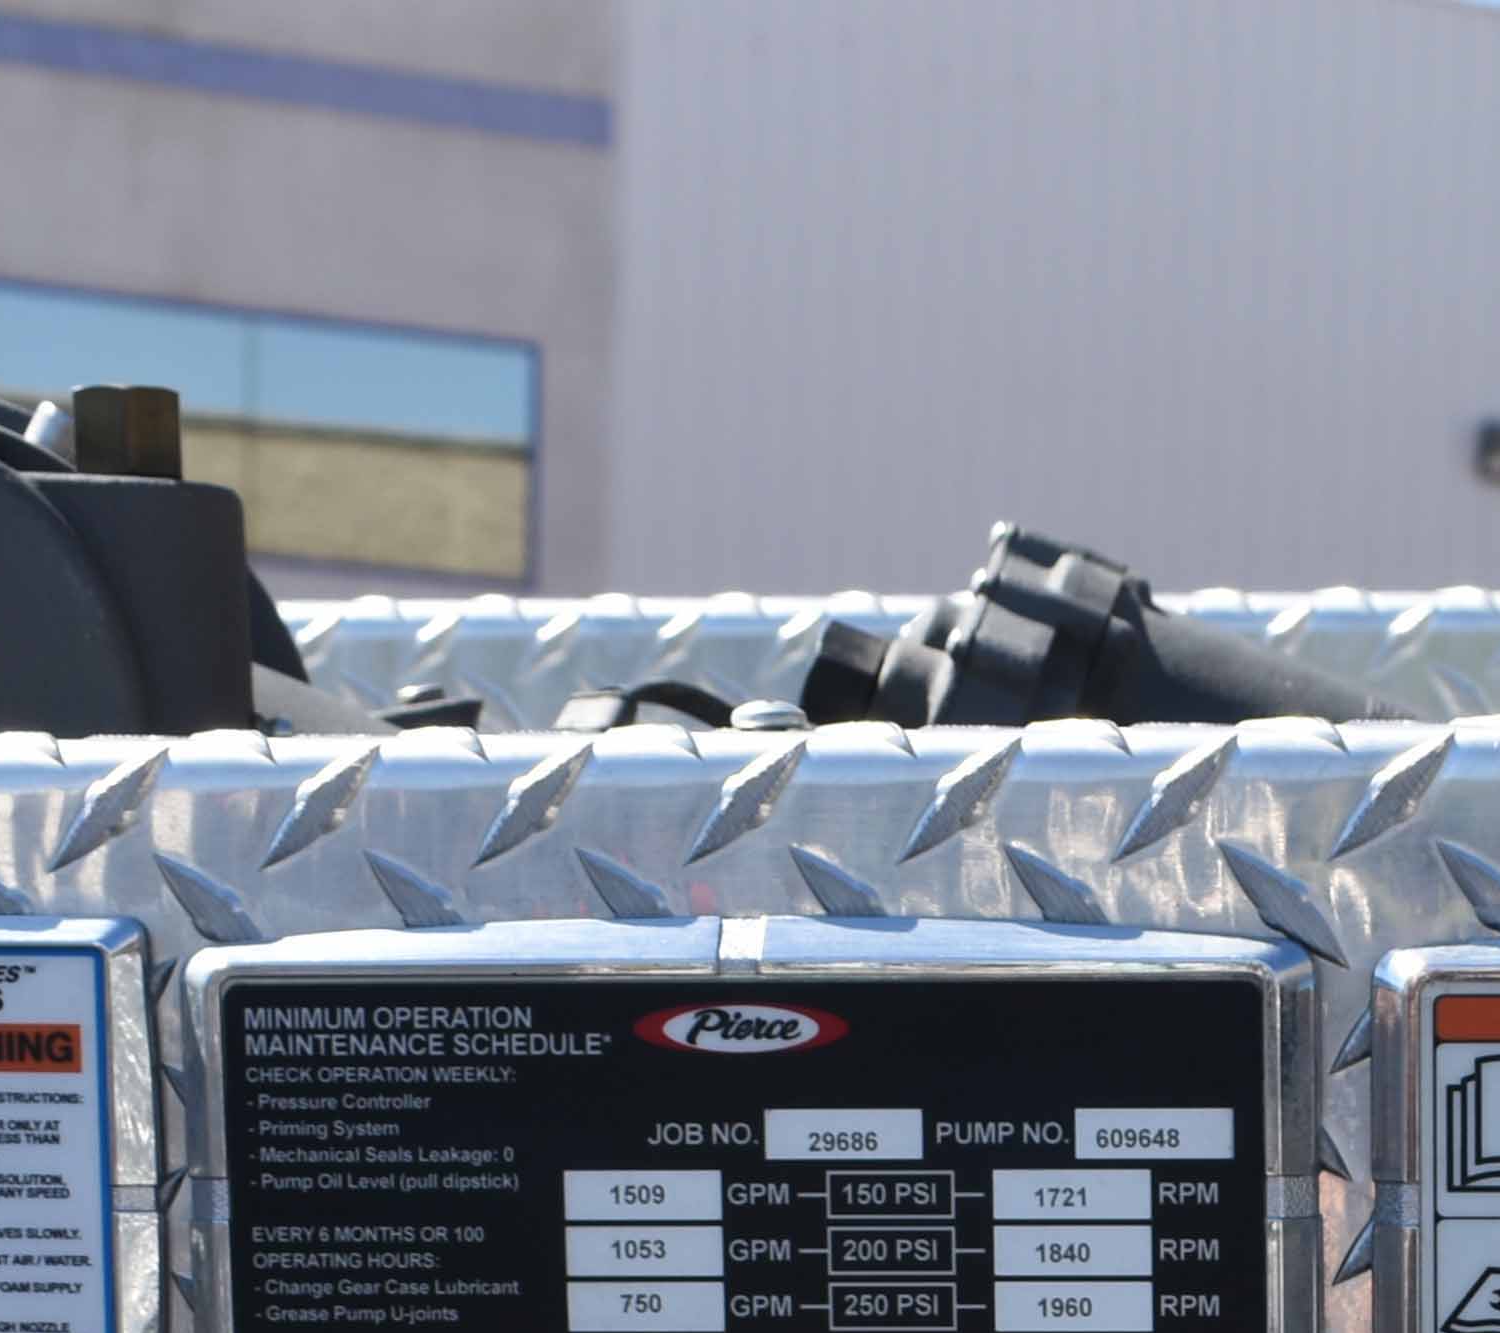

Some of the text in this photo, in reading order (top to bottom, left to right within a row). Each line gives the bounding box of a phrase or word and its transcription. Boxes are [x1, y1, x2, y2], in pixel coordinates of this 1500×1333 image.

[244, 1006, 532, 1031] MINIMUM OPERATION
[686, 1005, 801, 1046] Pierce
[246, 1066, 516, 1082] CHECK OPERATION WEEKLY:
[648, 1121, 1180, 1152] JOB NO. 29686 PUMP NO. 609648
[610, 1182, 1220, 1207] 1509 GPM 150 PSI 1721 RPM
[612, 1239, 1220, 1263] 1053 GPM 200 PSI 1840 RPM
[620, 1293, 1221, 1318] 750 GPM 250 PSI 1960 RPM
